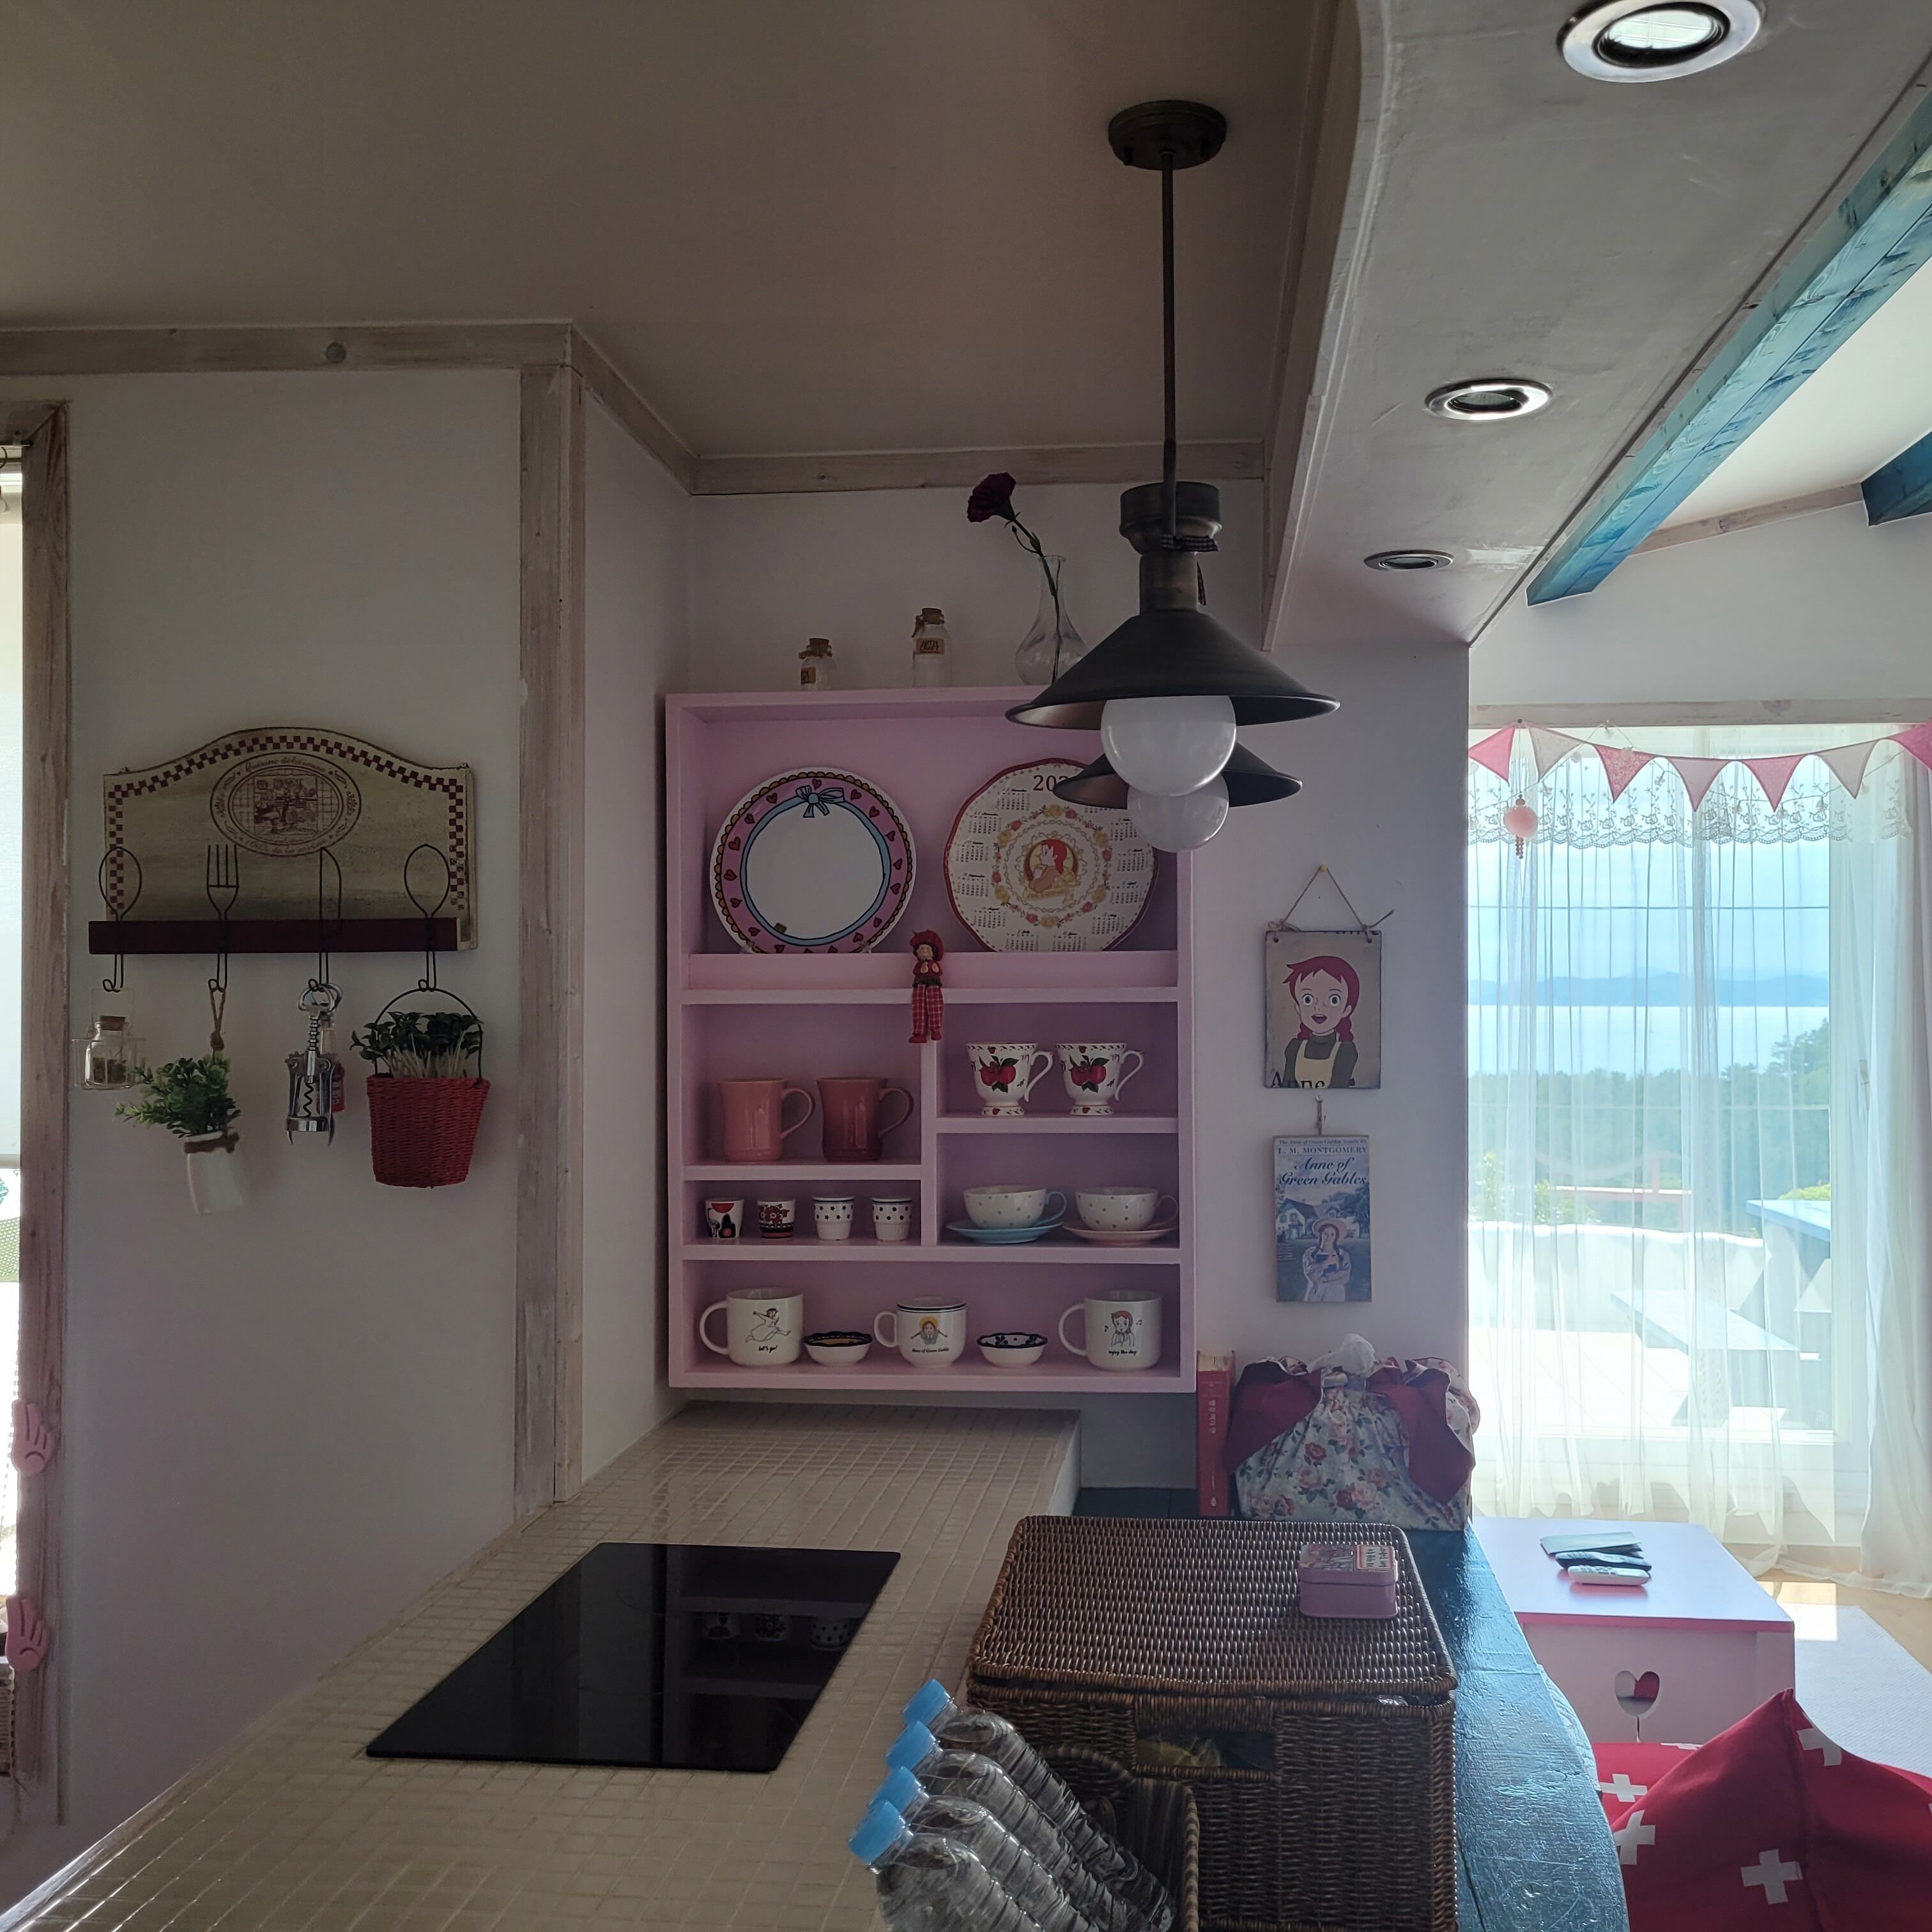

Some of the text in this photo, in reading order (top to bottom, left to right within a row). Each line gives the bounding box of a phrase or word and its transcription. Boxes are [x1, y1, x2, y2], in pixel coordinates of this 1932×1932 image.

[1294, 1157, 1354, 1173] Anne of
[1279, 1172, 1367, 1185] Green Gables
